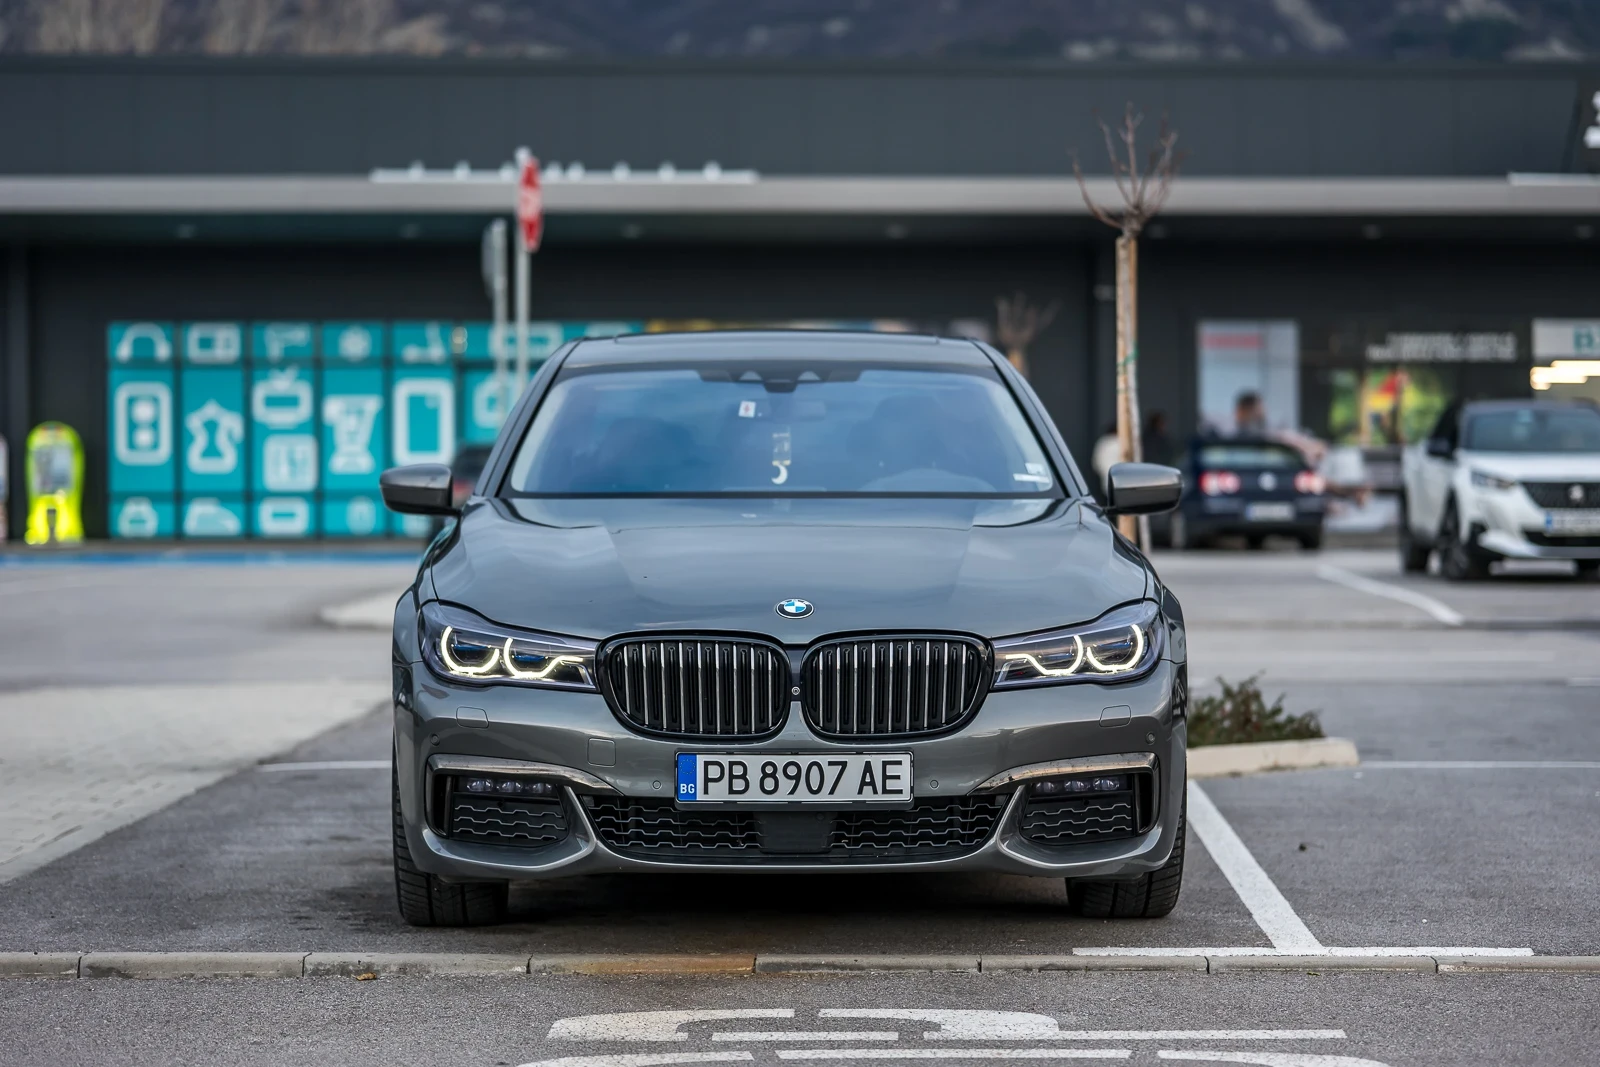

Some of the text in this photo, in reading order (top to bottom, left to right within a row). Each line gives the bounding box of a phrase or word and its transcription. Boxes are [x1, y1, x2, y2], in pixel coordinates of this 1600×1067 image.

[680, 783, 695, 794] BG
[703, 760, 904, 796] PB 8907 AE
